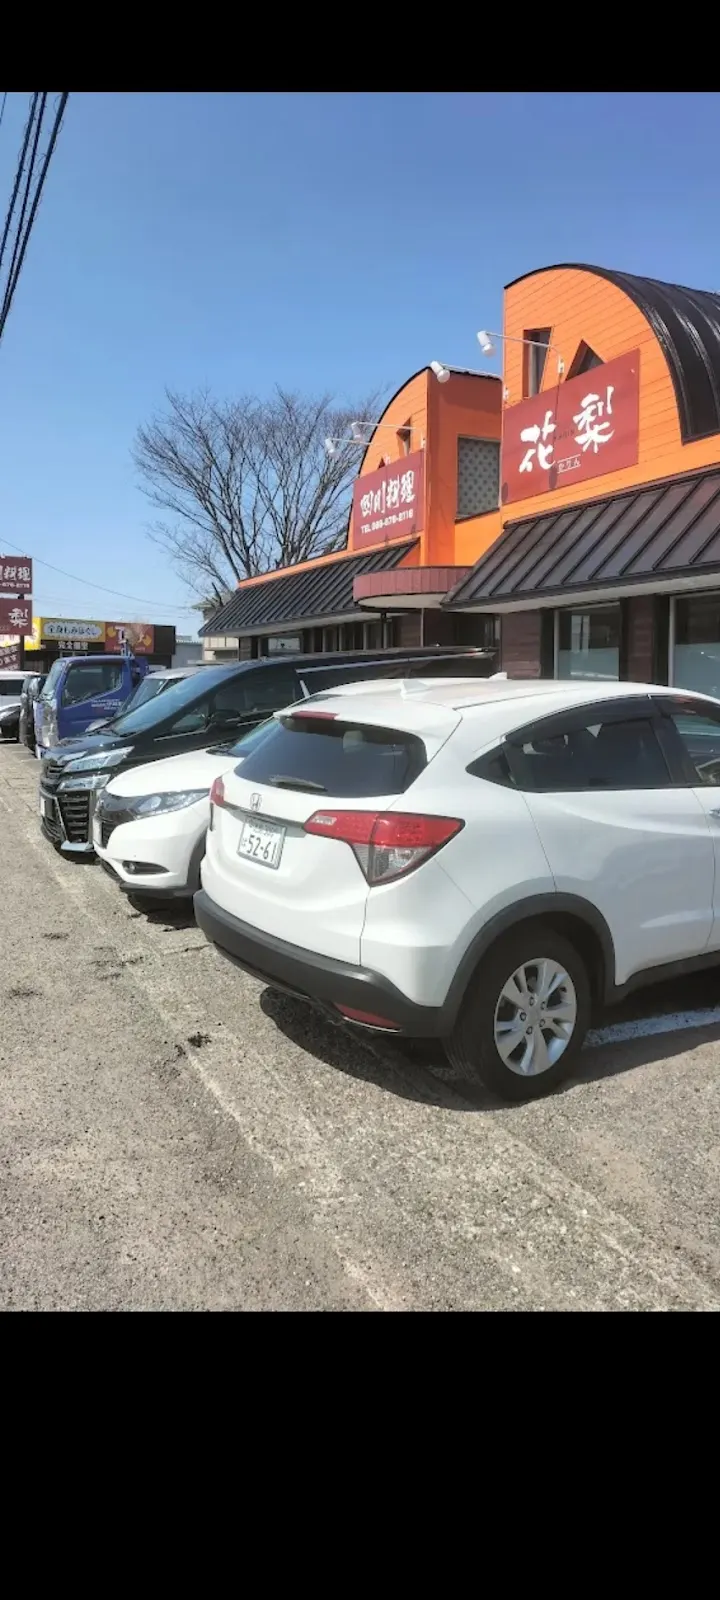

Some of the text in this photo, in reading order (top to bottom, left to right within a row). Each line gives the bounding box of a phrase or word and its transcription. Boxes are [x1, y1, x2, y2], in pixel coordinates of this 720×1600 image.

[519, 386, 615, 473] 花梨
[361, 470, 416, 518] 四川料理
